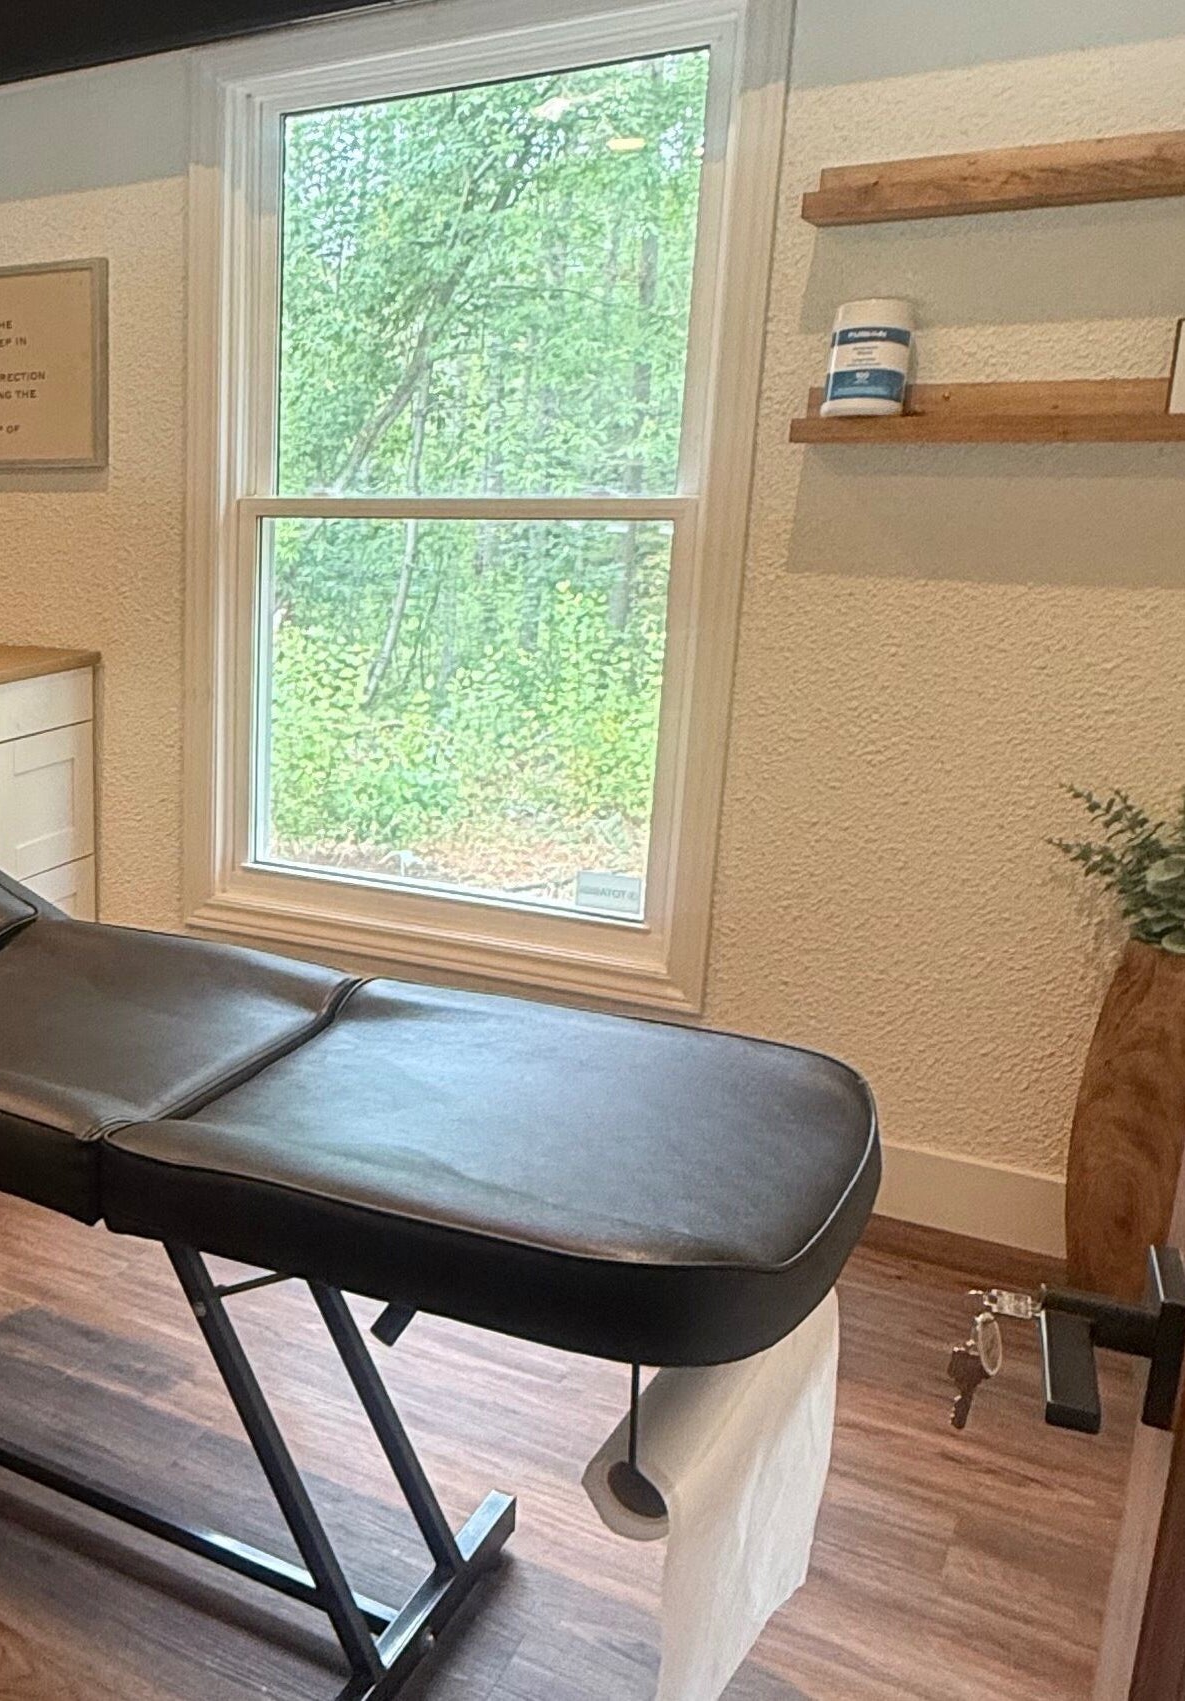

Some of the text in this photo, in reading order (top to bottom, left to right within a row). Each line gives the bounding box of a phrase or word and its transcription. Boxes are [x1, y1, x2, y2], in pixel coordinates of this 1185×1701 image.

[15, 337, 27, 346] IN
[15, 389, 37, 399] THE
[6, 425, 21, 434] OF
